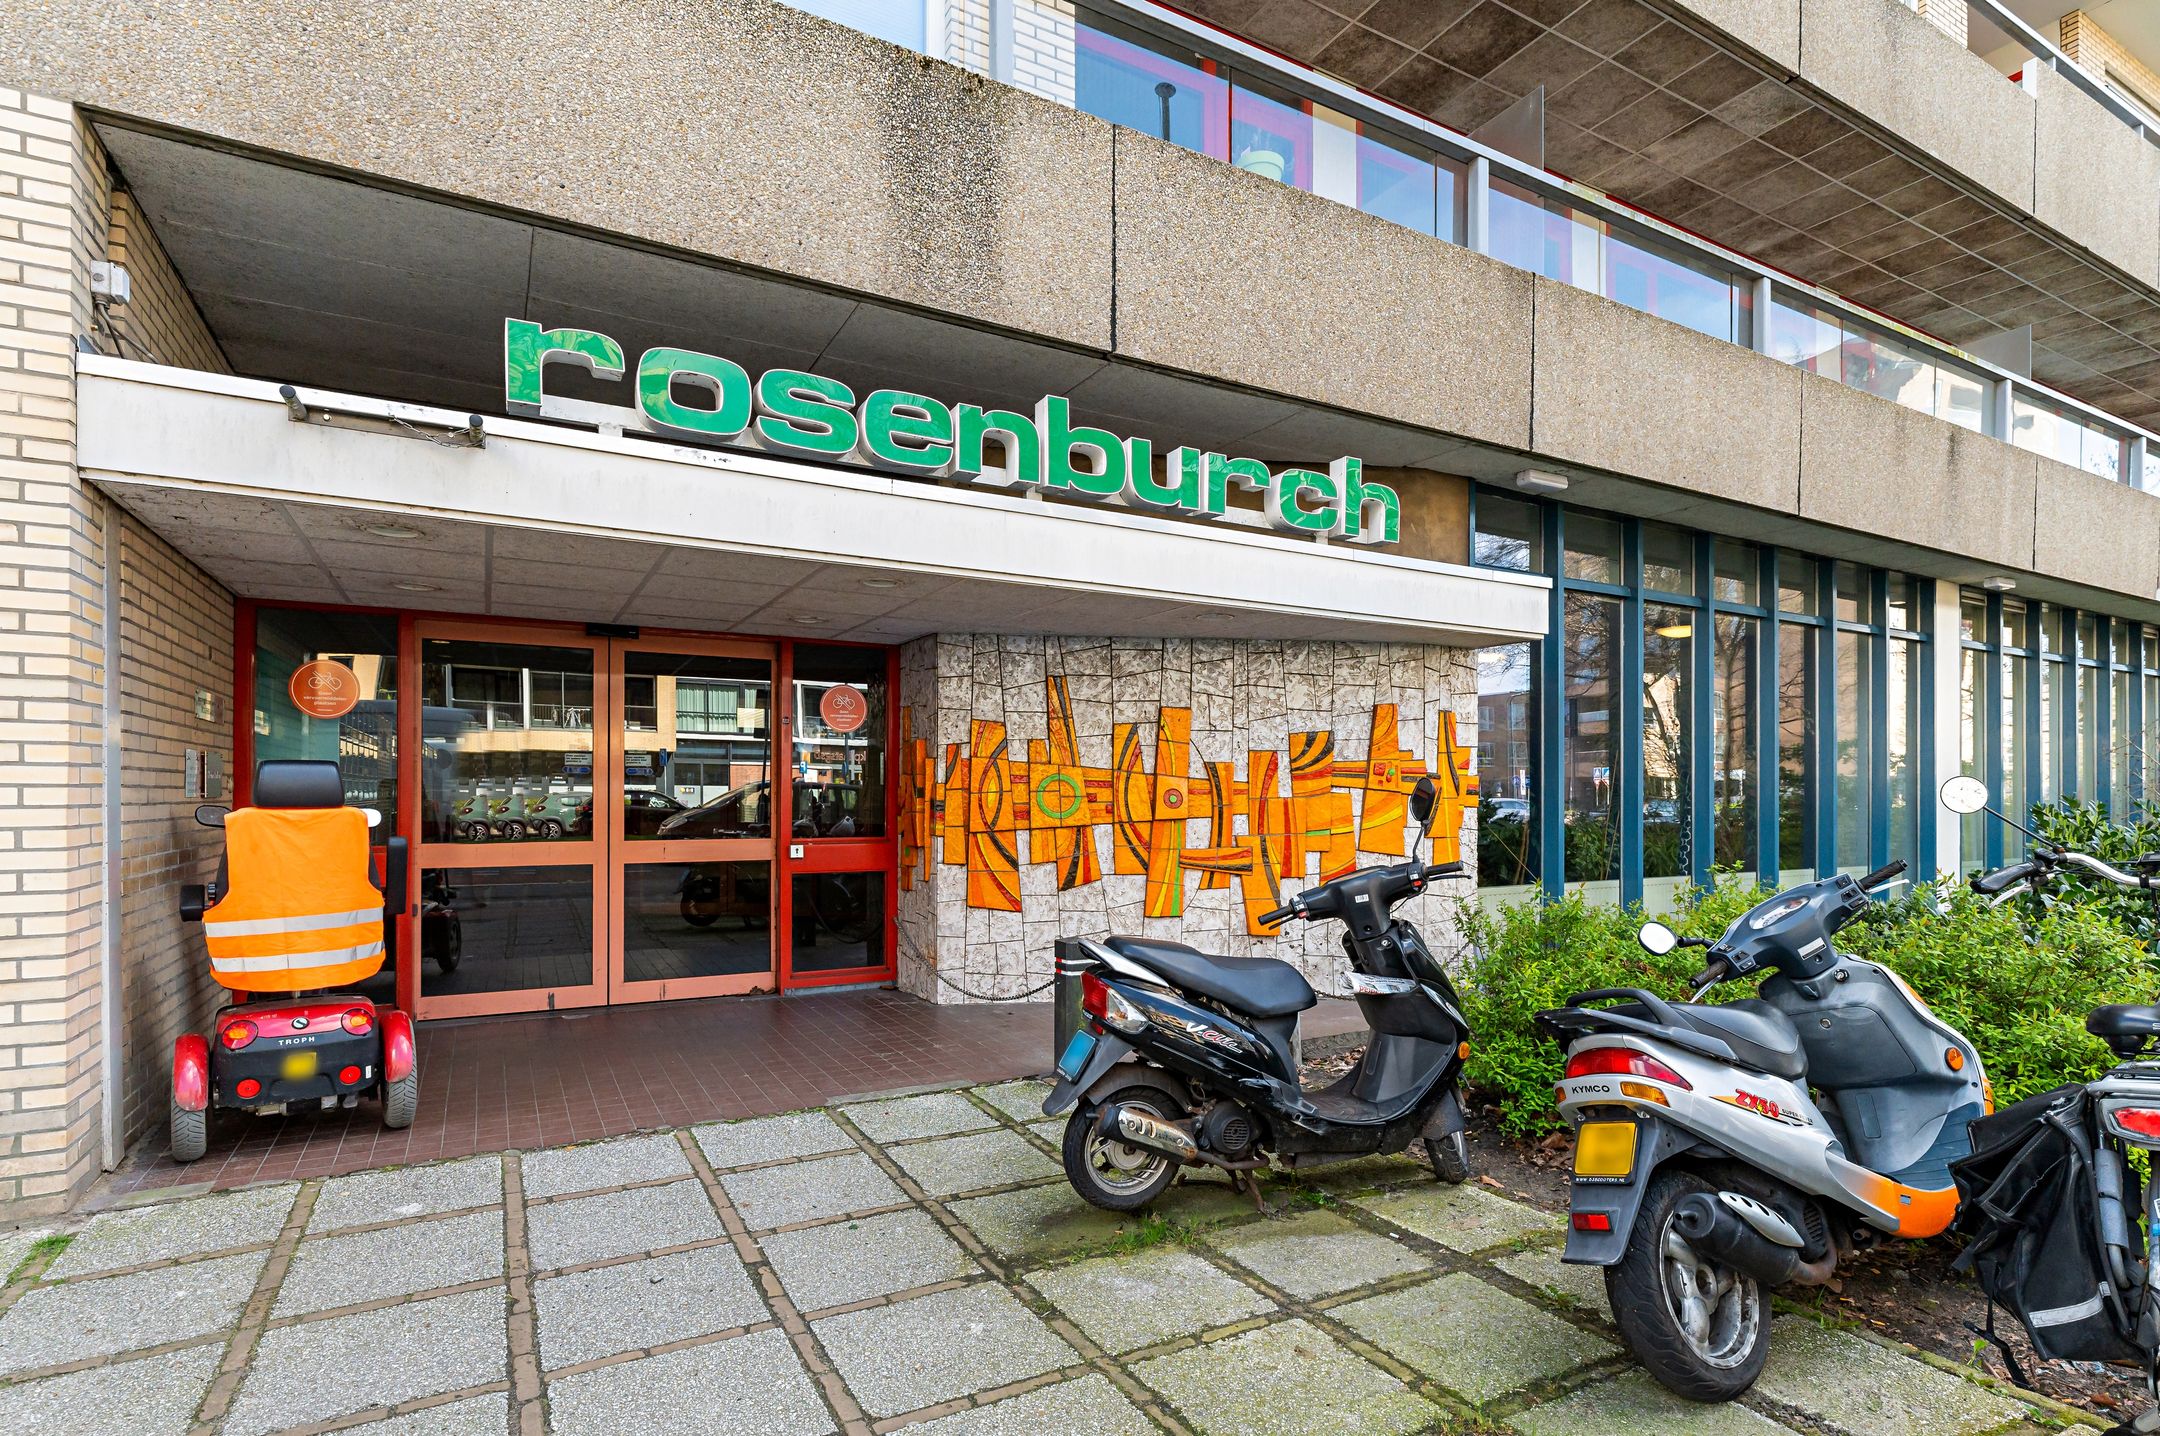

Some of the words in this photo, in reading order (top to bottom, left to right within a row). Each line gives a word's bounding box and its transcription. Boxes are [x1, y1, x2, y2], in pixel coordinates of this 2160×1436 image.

[504, 316, 1401, 546] rosenburch
[278, 1036, 315, 1046] TROPH
[1571, 1085, 1610, 1094] KYMCO
[1735, 1088, 1780, 1118] ZX50
